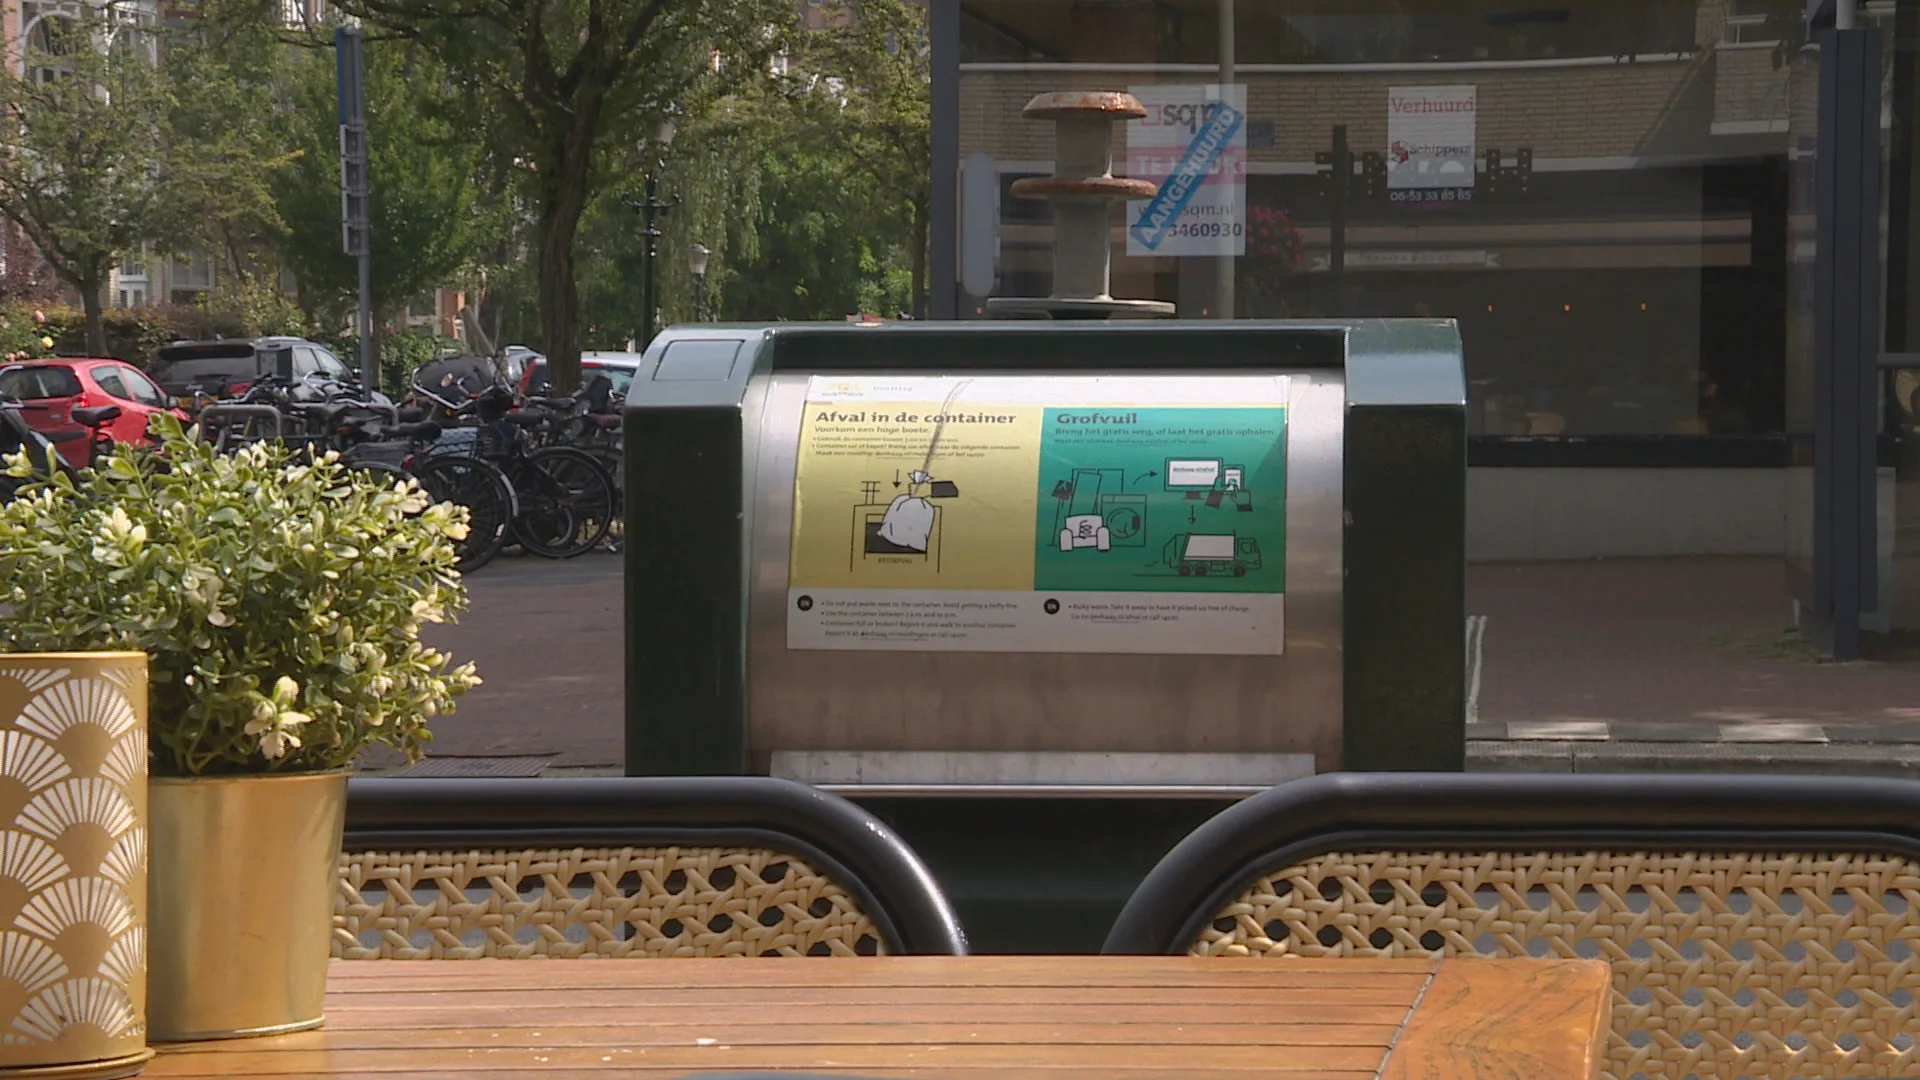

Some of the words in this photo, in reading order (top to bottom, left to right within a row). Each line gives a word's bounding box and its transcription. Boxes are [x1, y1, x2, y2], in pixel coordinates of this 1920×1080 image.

[1390, 97, 1475, 114] Verhuurd
[1137, 156, 1164, 175] TE
[1170, 156, 1239, 175] UR
[1140, 109, 1235, 242] AANGEHUURD
[816, 411, 866, 423] Afval
[871, 411, 889, 423] in
[895, 411, 919, 423] de
[923, 412, 1017, 424] container
[1056, 412, 1137, 424] Grofvuil
[876, 426, 900, 435] hoge
[1055, 427, 1083, 436] Breng
[1084, 427, 1100, 435] het
[1103, 427, 1130, 436] gratis
[1156, 427, 1166, 435] of
[1168, 427, 1187, 435] laat
[1206, 428, 1234, 437] gratis
